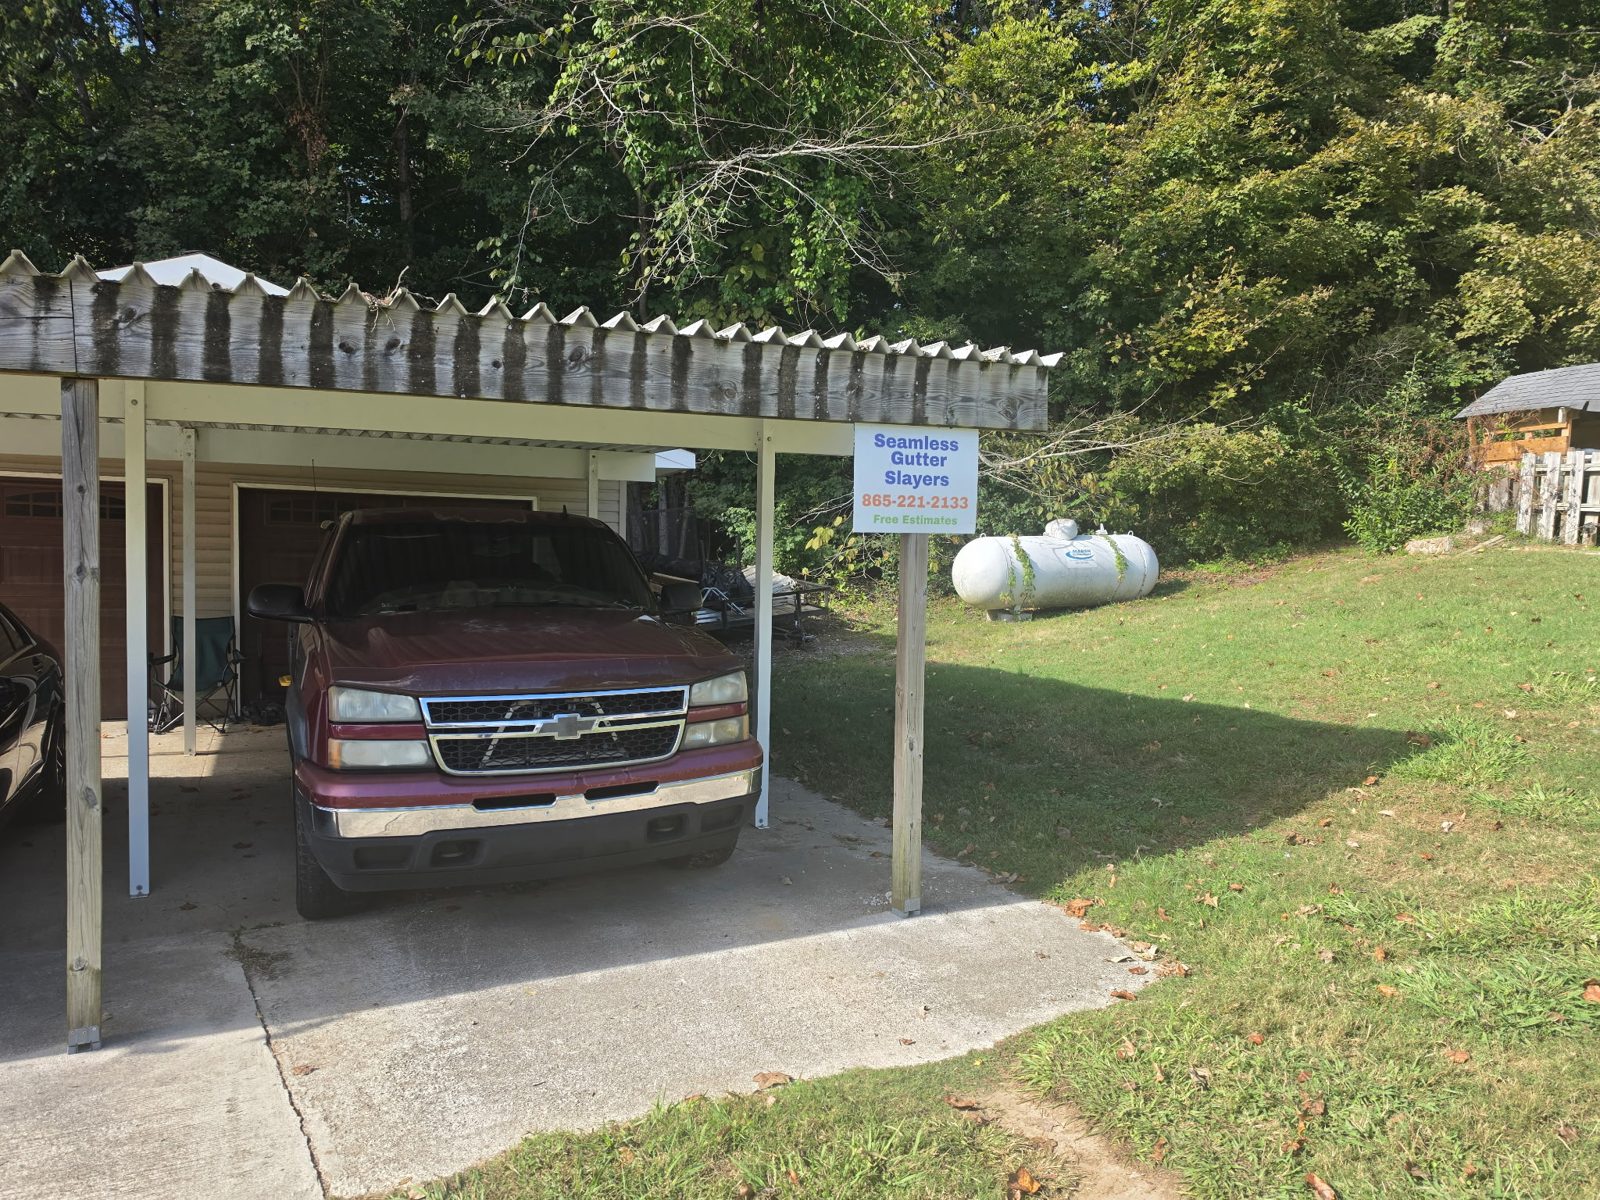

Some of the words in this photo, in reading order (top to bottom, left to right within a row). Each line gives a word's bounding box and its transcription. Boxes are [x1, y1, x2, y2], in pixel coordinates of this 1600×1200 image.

[874, 433, 959, 451] Seamless
[891, 451, 947, 467] Gutter
[885, 470, 949, 489] Slayers
[862, 494, 968, 509] 865-221-2133
[873, 514, 899, 524] Free
[903, 515, 958, 525] Estimates
